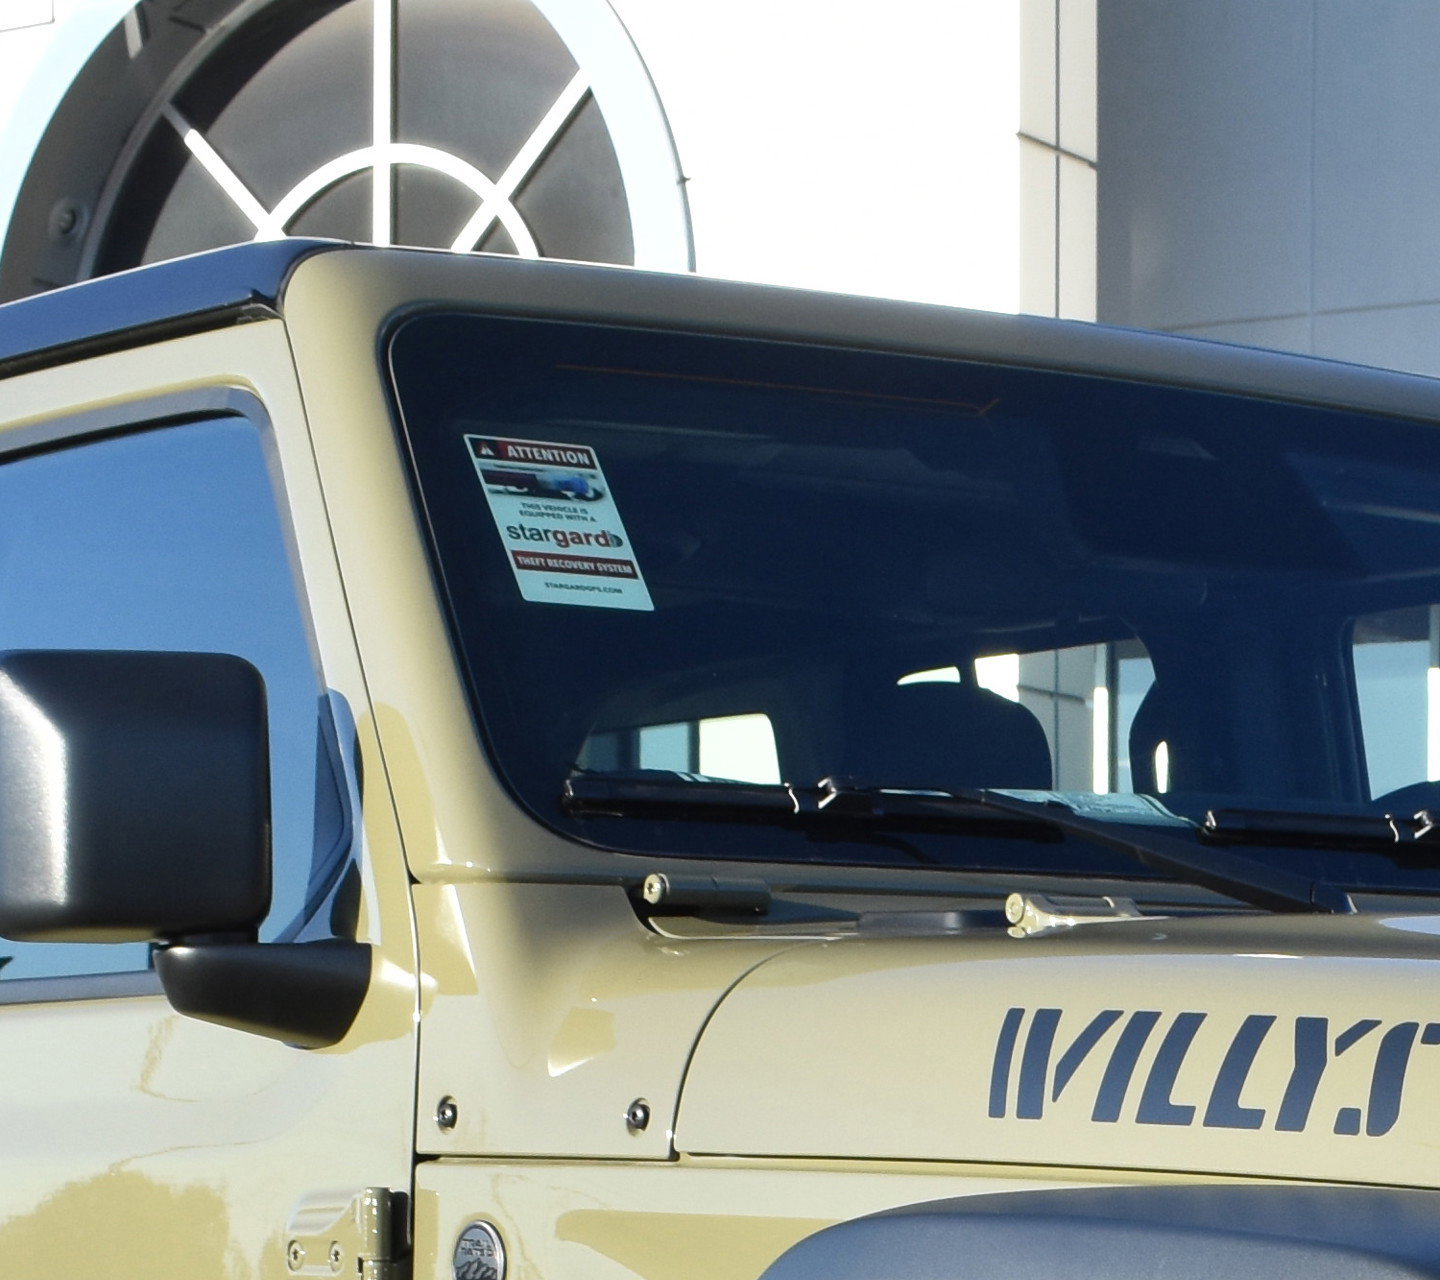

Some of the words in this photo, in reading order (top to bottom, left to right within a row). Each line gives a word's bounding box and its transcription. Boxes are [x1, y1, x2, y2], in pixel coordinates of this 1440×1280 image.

[507, 445, 591, 465] ATTENTION
[521, 503, 541, 511] THIS
[542, 504, 578, 513] VEHICLE
[519, 510, 563, 519] EQUIPPED
[565, 514, 588, 522] WITH
[517, 556, 545, 567] THEFT
[546, 559, 596, 571] RECOVERY
[596, 562, 633, 574] SYSTEM
